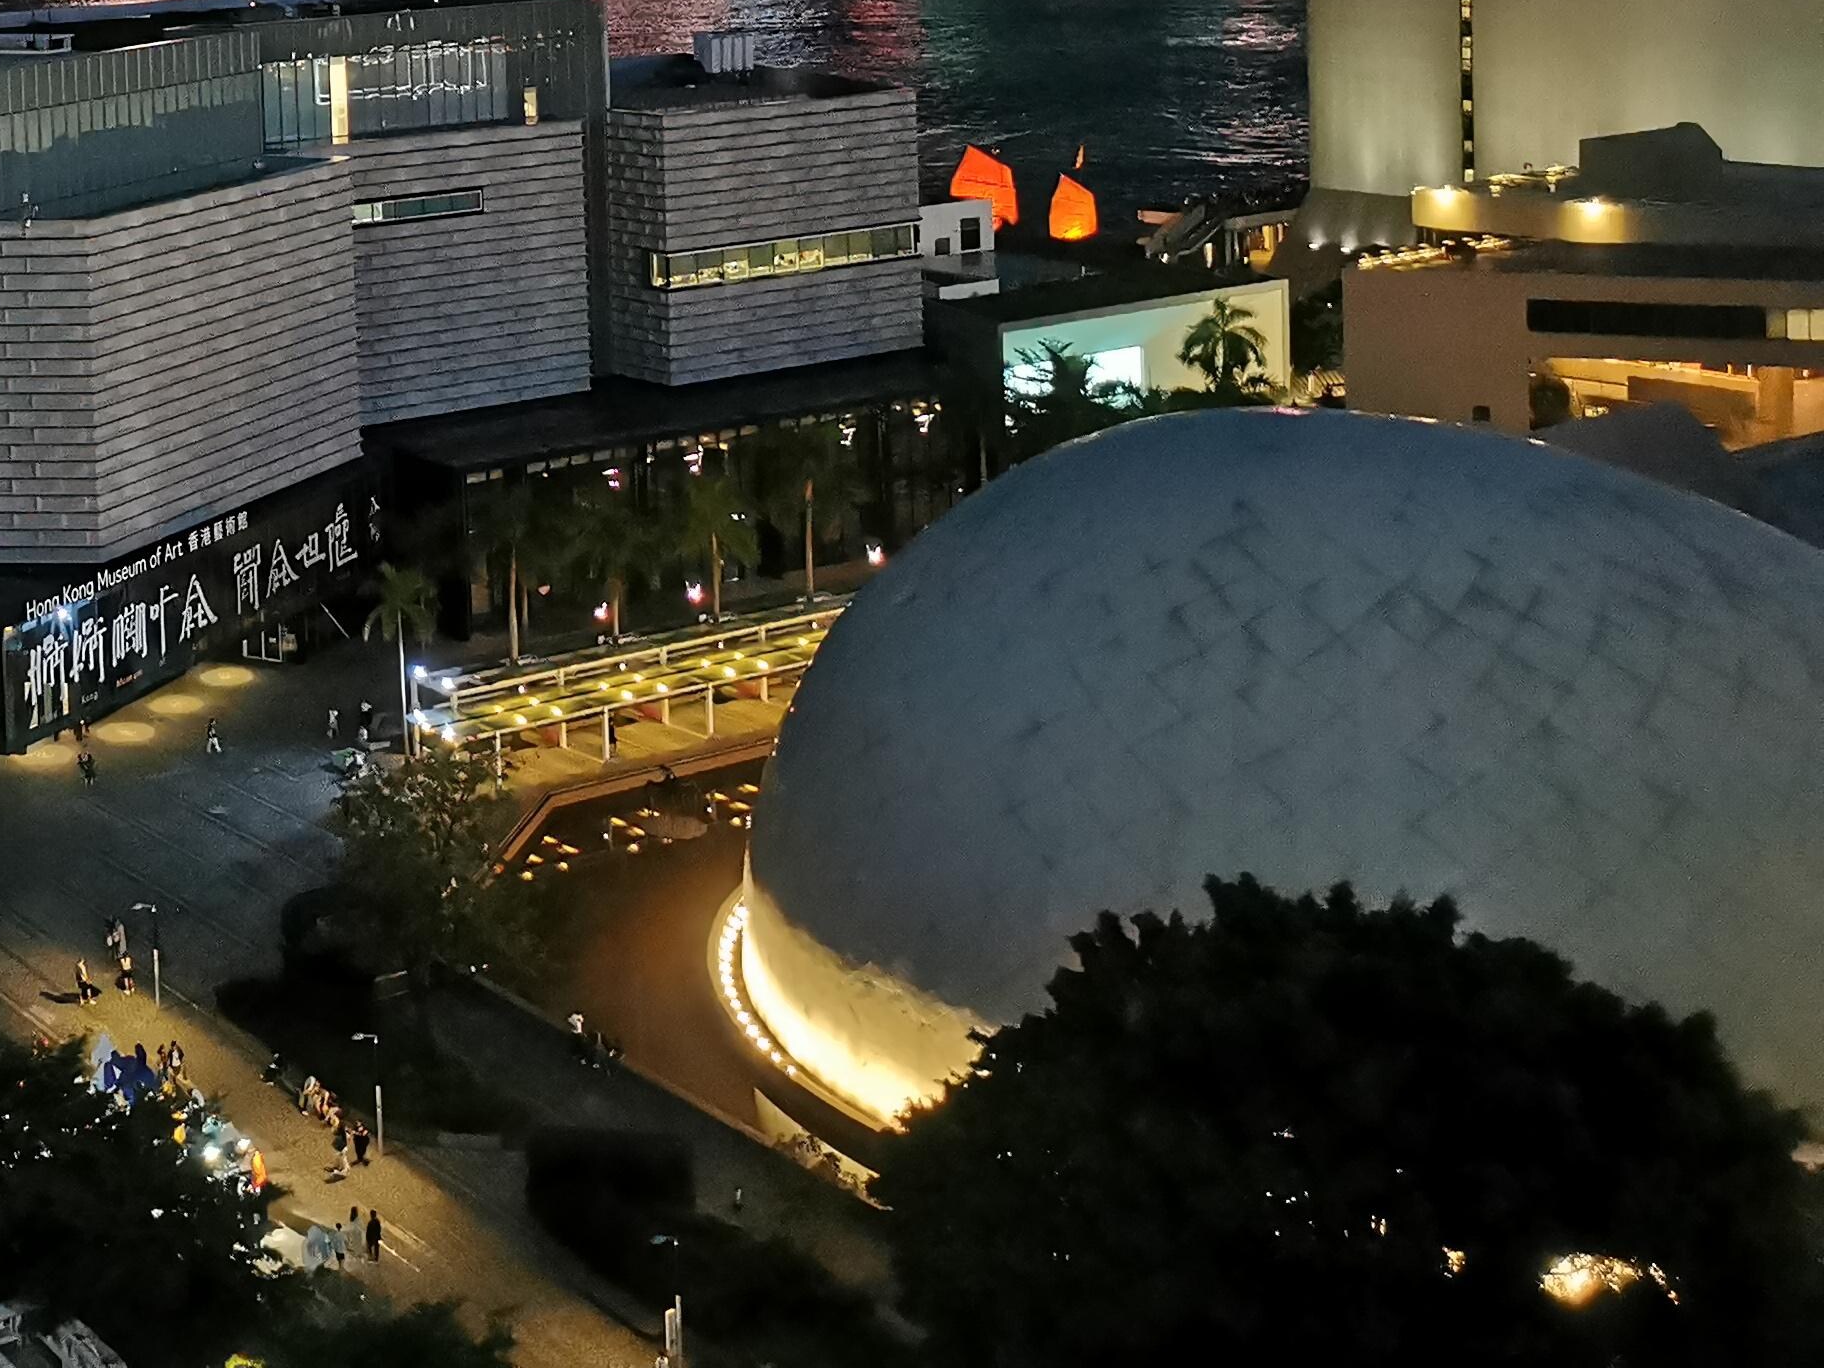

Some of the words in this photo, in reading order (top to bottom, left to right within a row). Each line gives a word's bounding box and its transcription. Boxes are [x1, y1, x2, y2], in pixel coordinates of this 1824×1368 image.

[26, 594, 60, 621] Hong
[62, 579, 95, 603] Kong
[97, 558, 147, 592] Museum
[149, 546, 163, 570] of
[164, 540, 184, 564] Art
[188, 510, 249, 553] 香港藝術館
